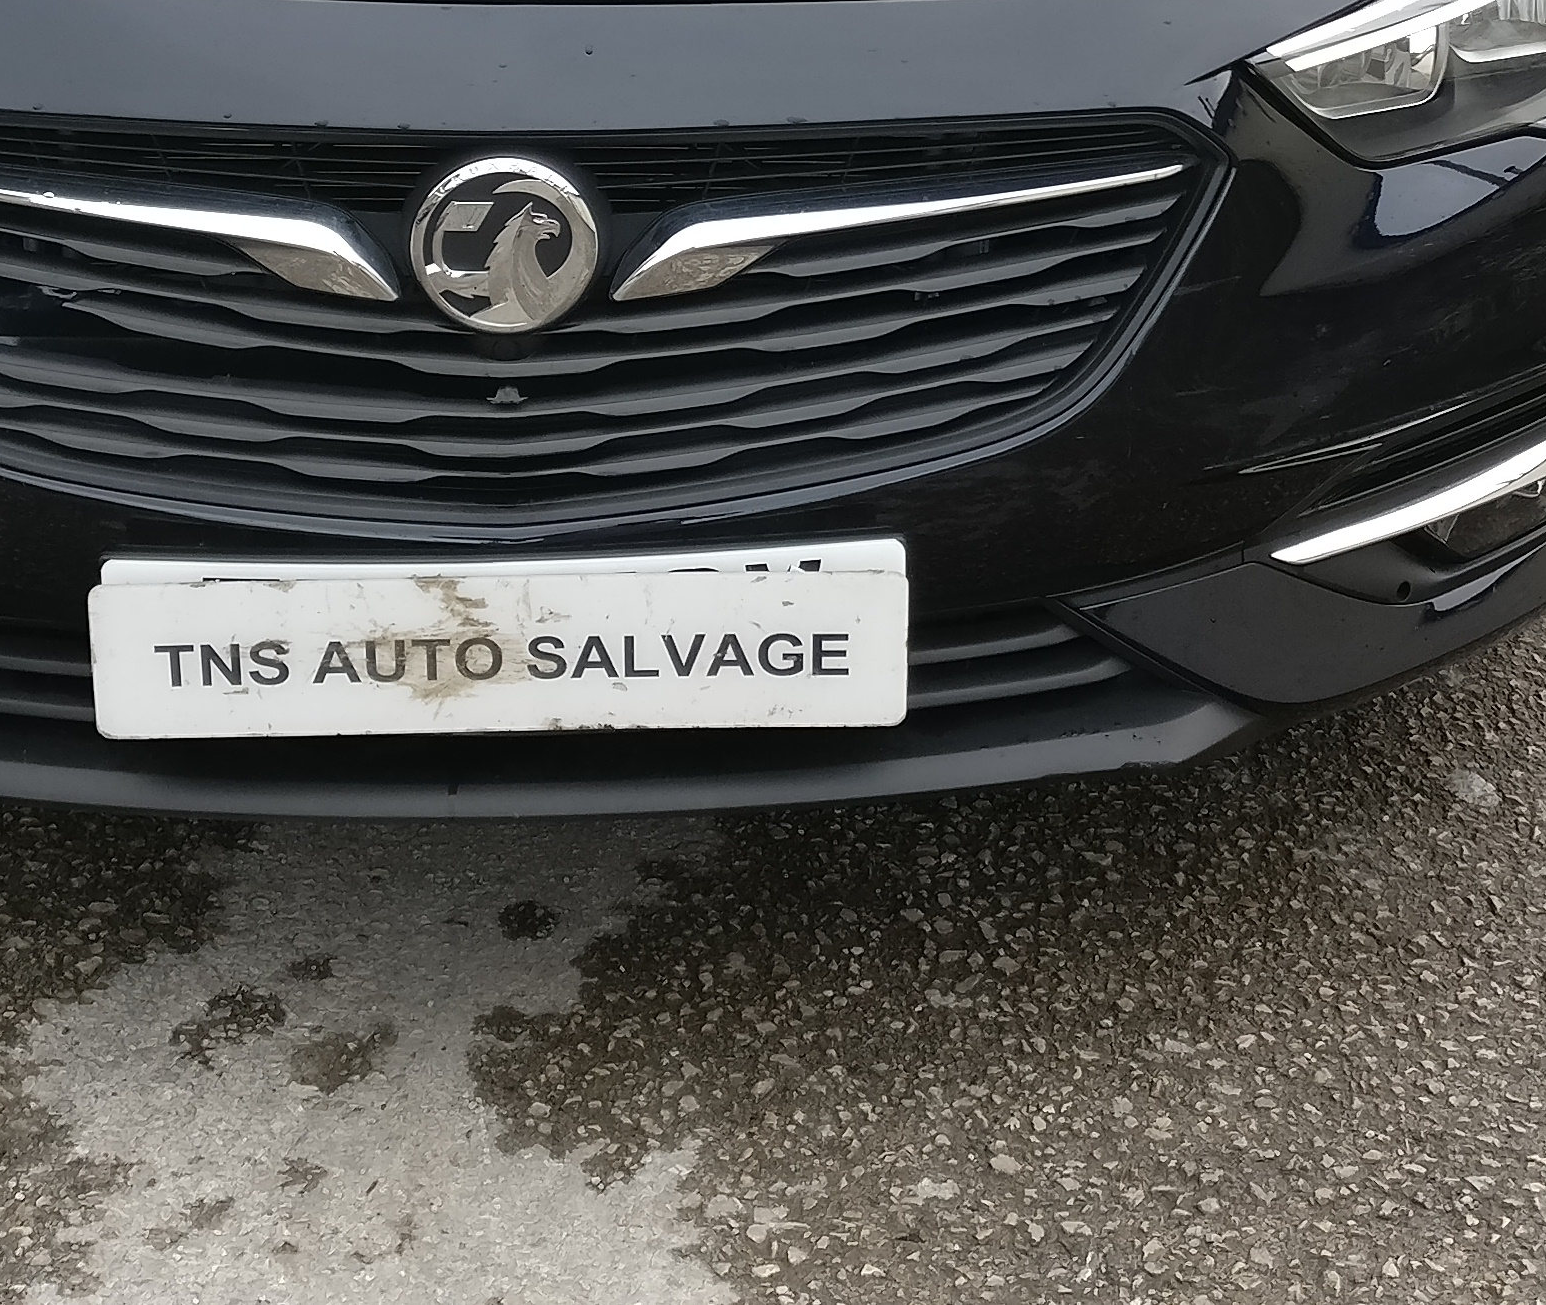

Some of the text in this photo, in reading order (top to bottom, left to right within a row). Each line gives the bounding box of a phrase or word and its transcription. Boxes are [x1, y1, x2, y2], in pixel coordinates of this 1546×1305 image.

[154, 631, 851, 688] TNS AUTO SALVAGE
